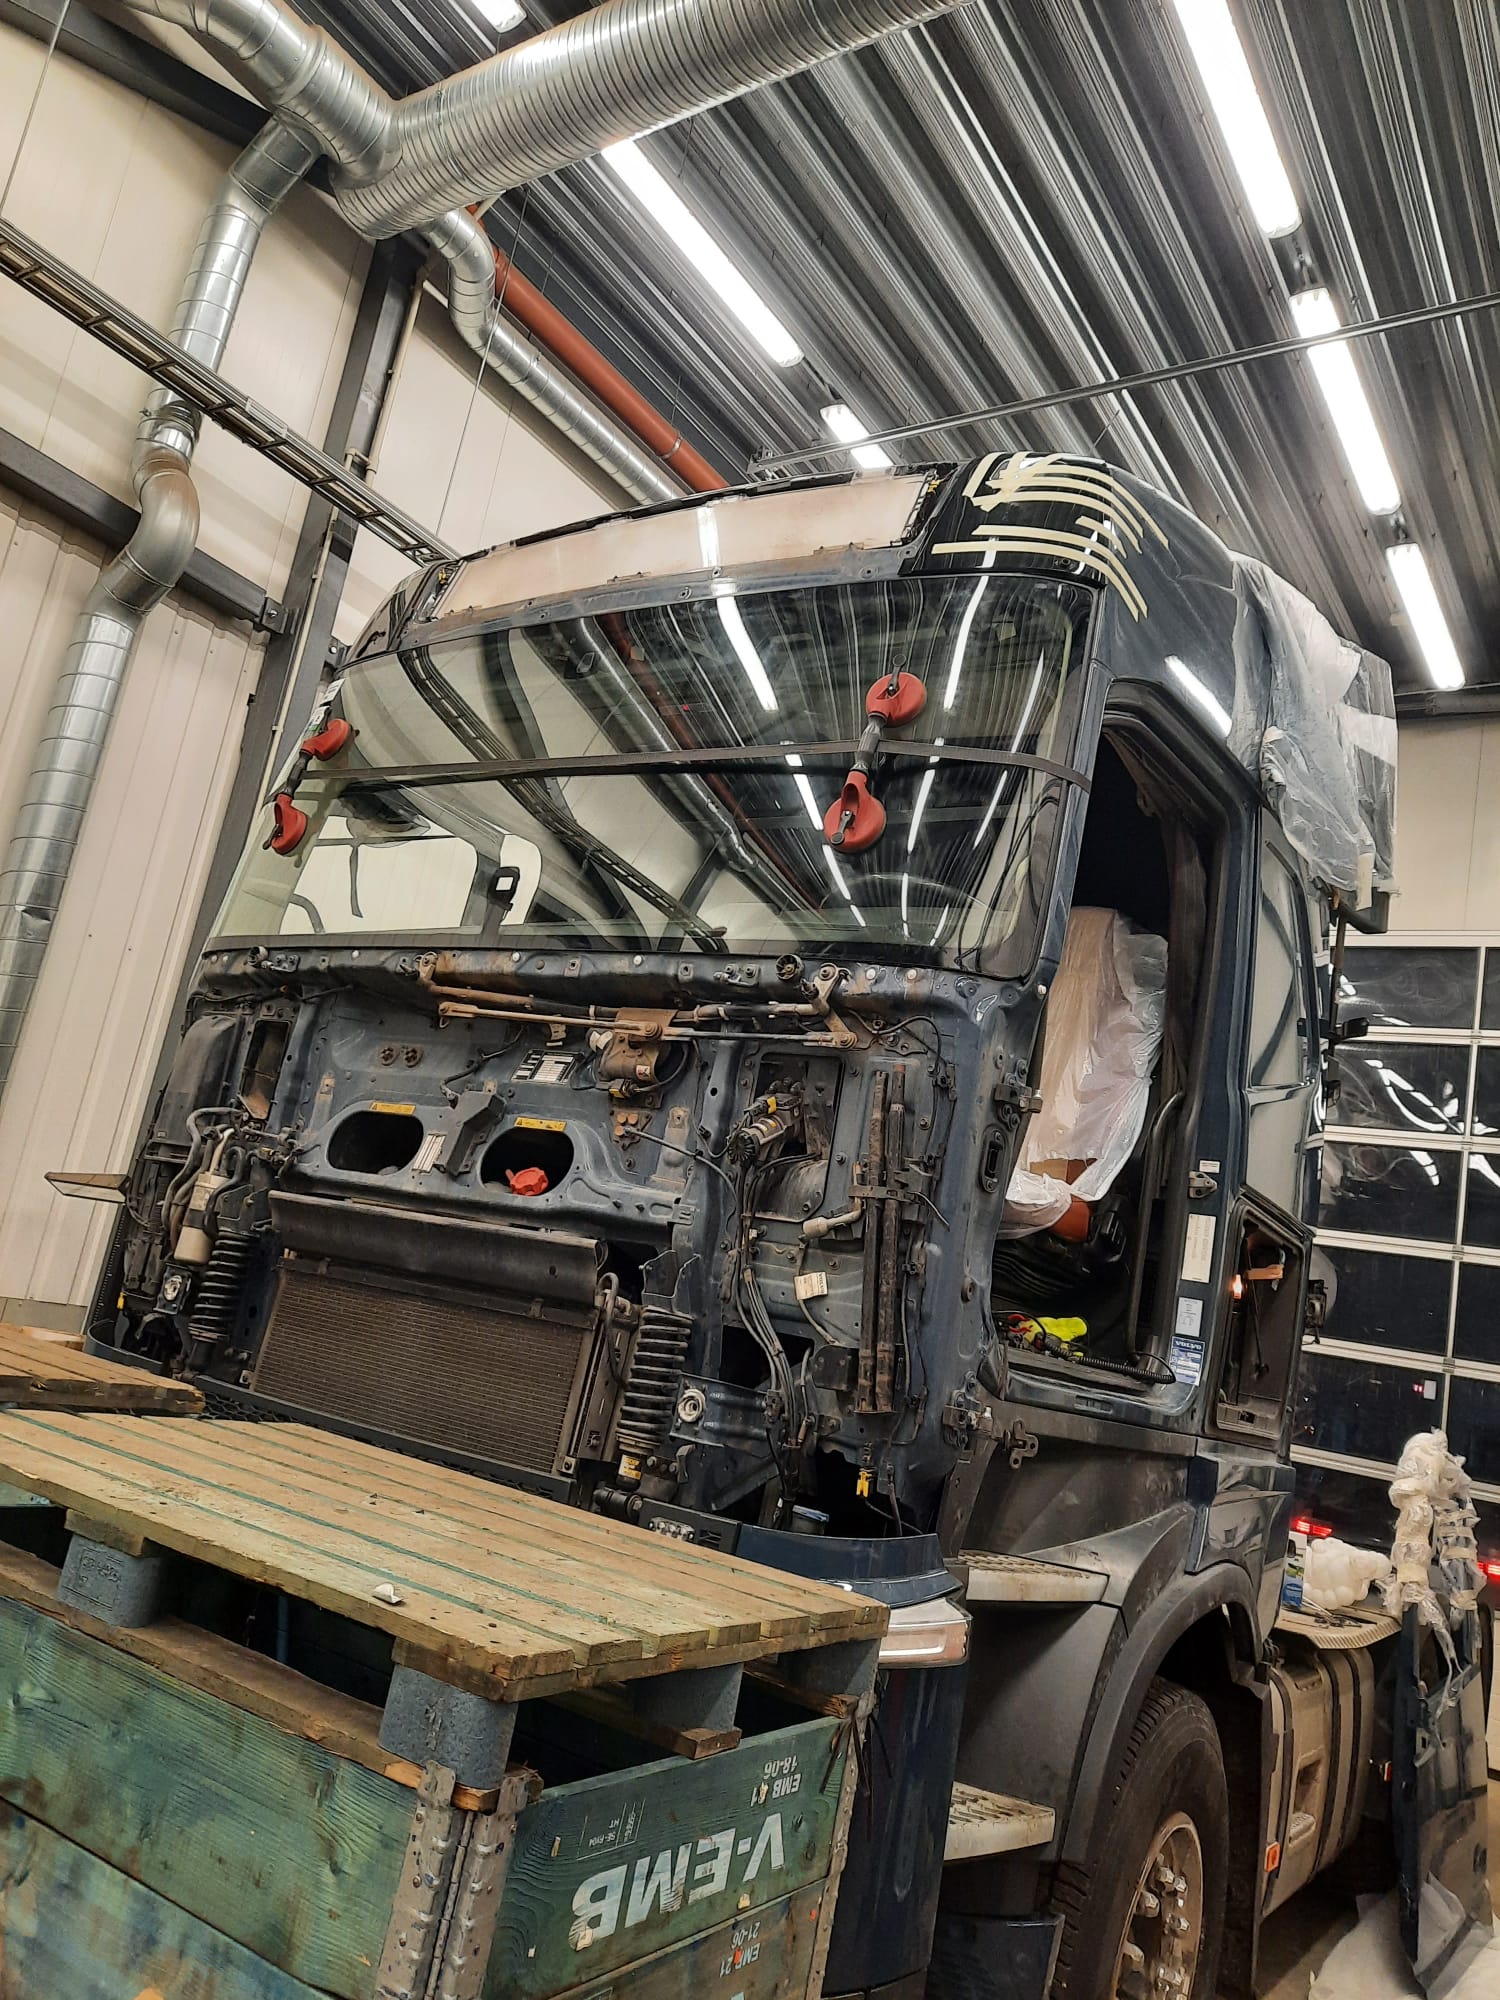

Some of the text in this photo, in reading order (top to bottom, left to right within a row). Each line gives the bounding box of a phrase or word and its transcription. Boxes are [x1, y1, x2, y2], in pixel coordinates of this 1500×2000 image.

[763, 1754, 798, 1780] 18-06
[772, 1773, 801, 1799] EMB
[568, 1813, 785, 1951] V-EMB
[730, 1921, 761, 1950] 21-06
[719, 1955, 734, 1979] 21
